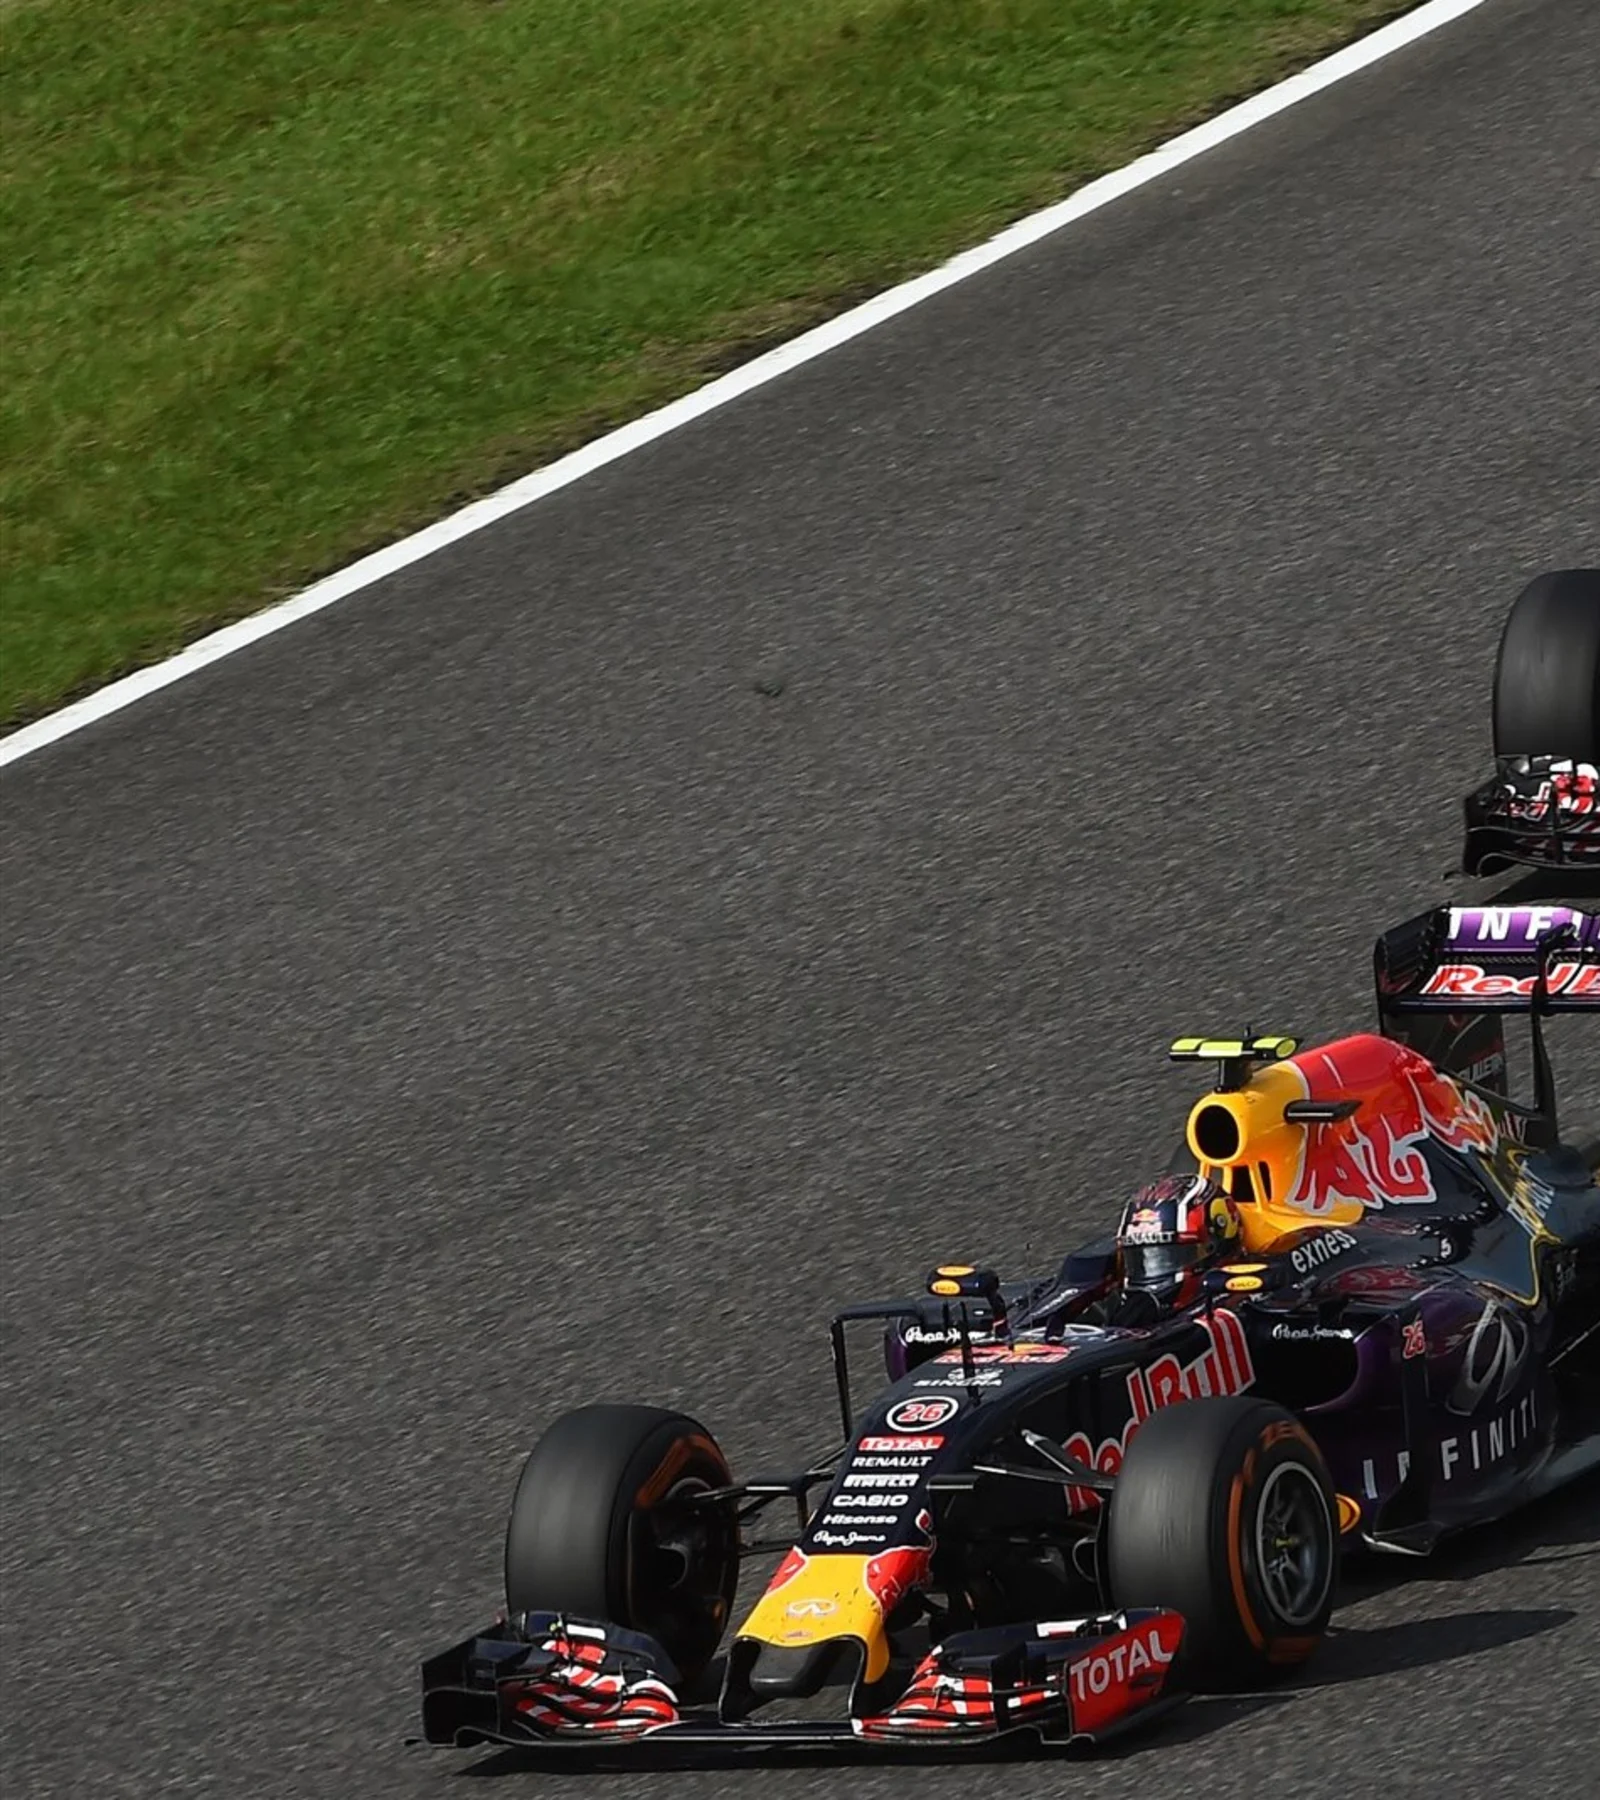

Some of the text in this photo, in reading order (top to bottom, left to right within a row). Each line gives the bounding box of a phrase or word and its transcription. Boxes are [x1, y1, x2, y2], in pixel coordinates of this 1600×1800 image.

[1402, 1320, 1426, 1360] 26
[896, 1403, 949, 1422] 26
[862, 1437, 940, 1451] TOTAL
[852, 1456, 932, 1467] RENAULT
[843, 1474, 919, 1487] PIRELLI
[832, 1494, 909, 1506] CASIO
[822, 1514, 898, 1525] Hisense
[1070, 1630, 1174, 1700] TOTAL
